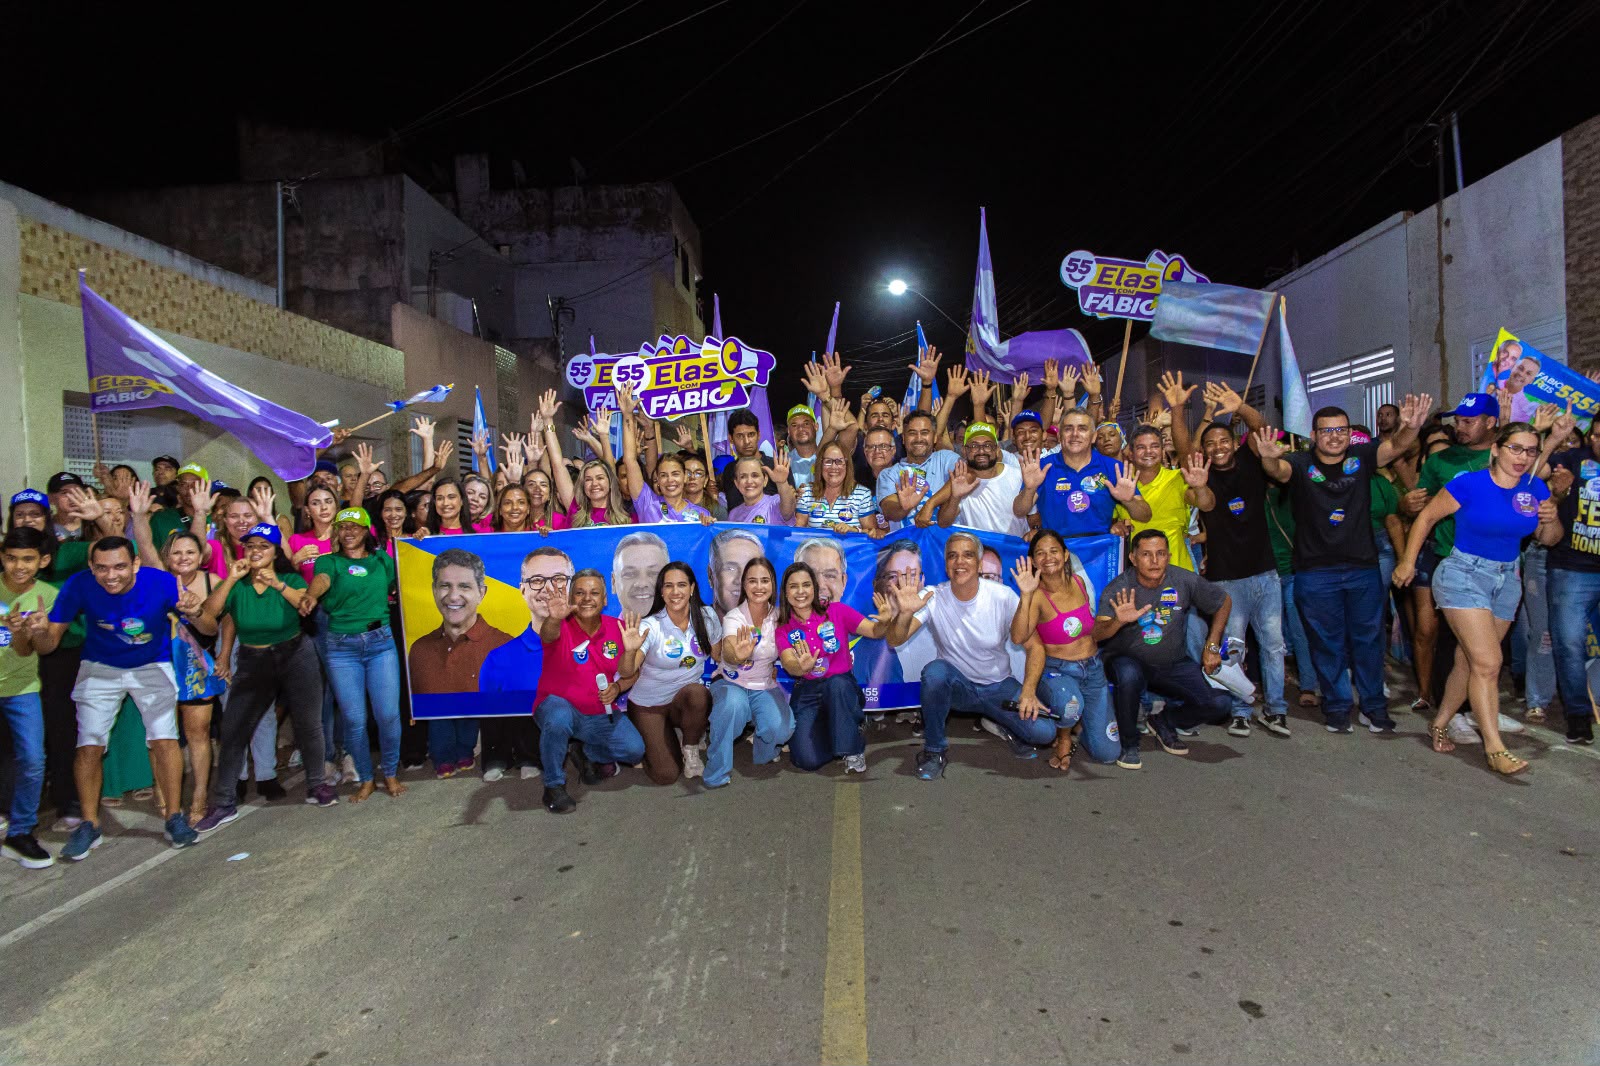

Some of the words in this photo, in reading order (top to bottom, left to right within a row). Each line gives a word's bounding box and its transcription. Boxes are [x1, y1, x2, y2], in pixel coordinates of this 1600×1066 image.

[1065, 257, 1094, 275] 55
[1096, 266, 1160, 290] Elas
[569, 361, 593, 377] 55
[616, 363, 645, 382] 55
[654, 361, 719, 386] Elas
[96, 376, 148, 390] Elas
[679, 382, 698, 390] COM
[1533, 377, 1555, 394] REIS
[649, 386, 733, 416] FÁBIO
[1070, 492, 1084, 502] 55
[1516, 493, 1532, 502] 55
